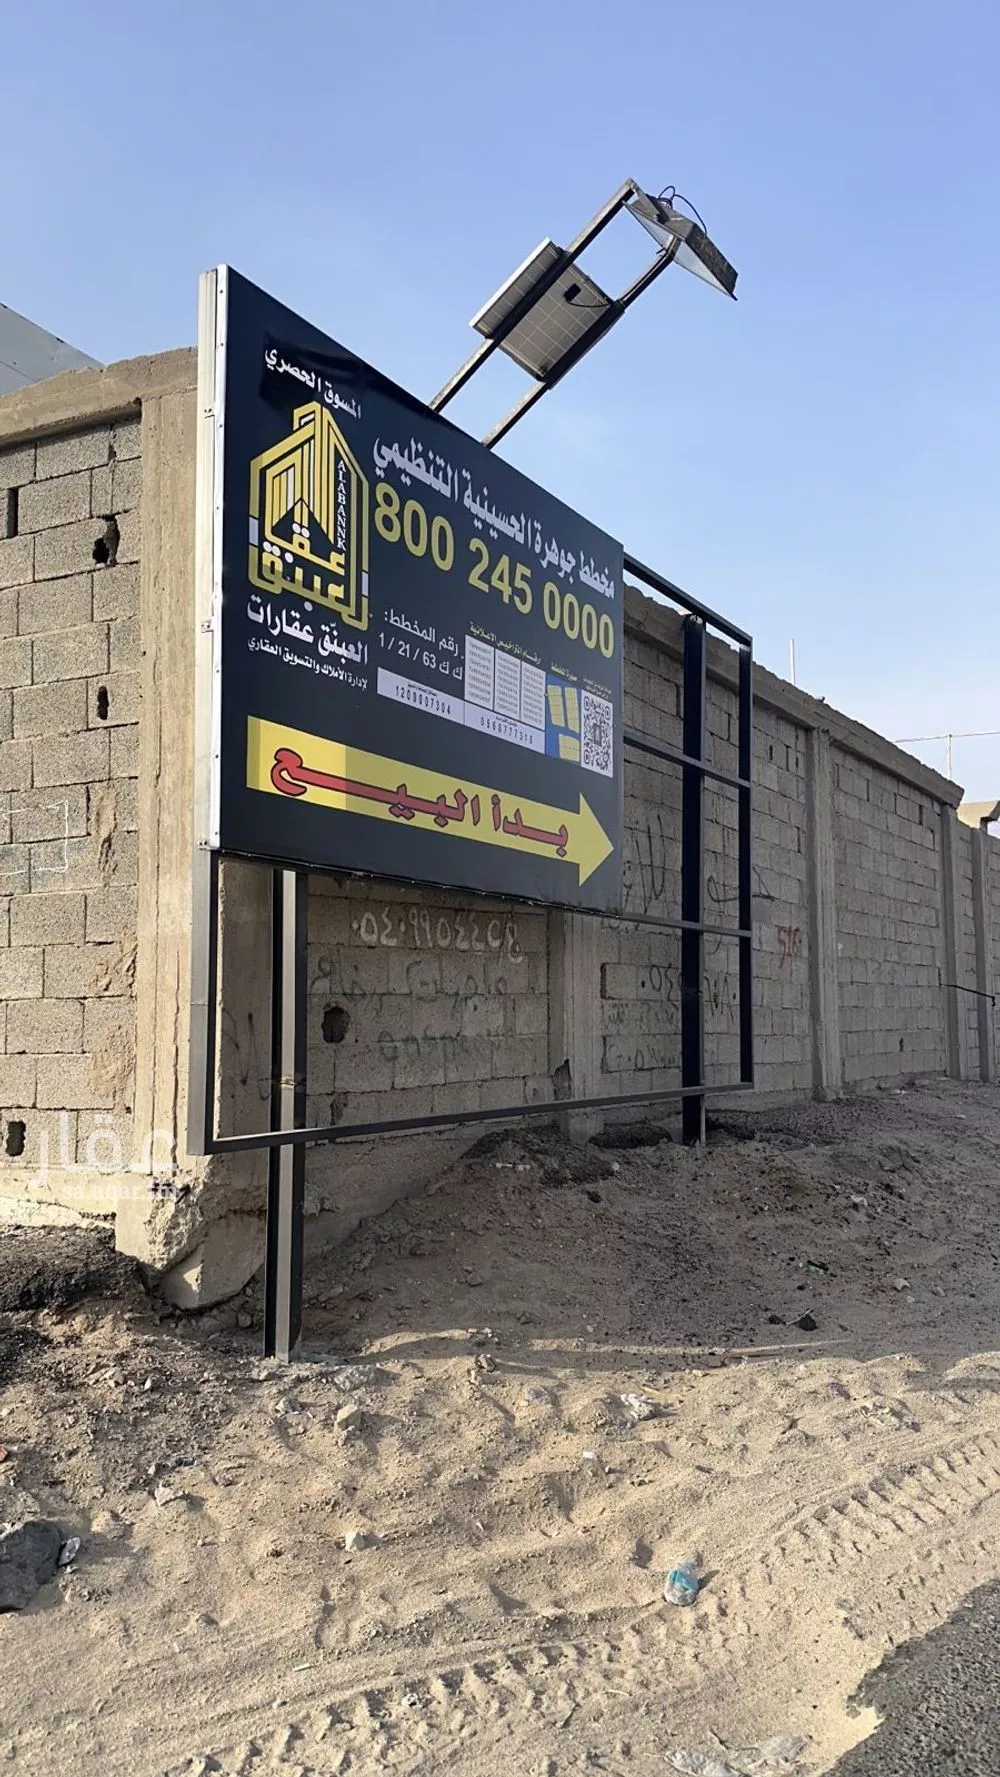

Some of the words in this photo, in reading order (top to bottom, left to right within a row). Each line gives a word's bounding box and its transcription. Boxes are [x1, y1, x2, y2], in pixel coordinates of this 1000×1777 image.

[264, 349, 322, 393] الحصري
[324, 380, 362, 420] المسوق
[373, 437, 459, 504] التنظيمي
[337, 460, 347, 552] ALABANNK
[463, 467, 533, 550] الحسينية
[374, 482, 455, 572] 800
[467, 537, 533, 615] 245
[543, 580, 614, 659] 0000
[534, 519, 577, 585] جوهرة
[578, 550, 615, 600] مخطط
[247, 594, 315, 645] عقارات
[378, 631, 385, 648] 1
[384, 608, 436, 643] المخطط:
[247, 636, 283, 657] العقاري
[282, 646, 321, 675] والتسويق
[398, 640, 411, 658] 21
[422, 650, 437, 669] 63
[439, 635, 459, 658] رقم
[491, 794, 569, 857] بدأ
